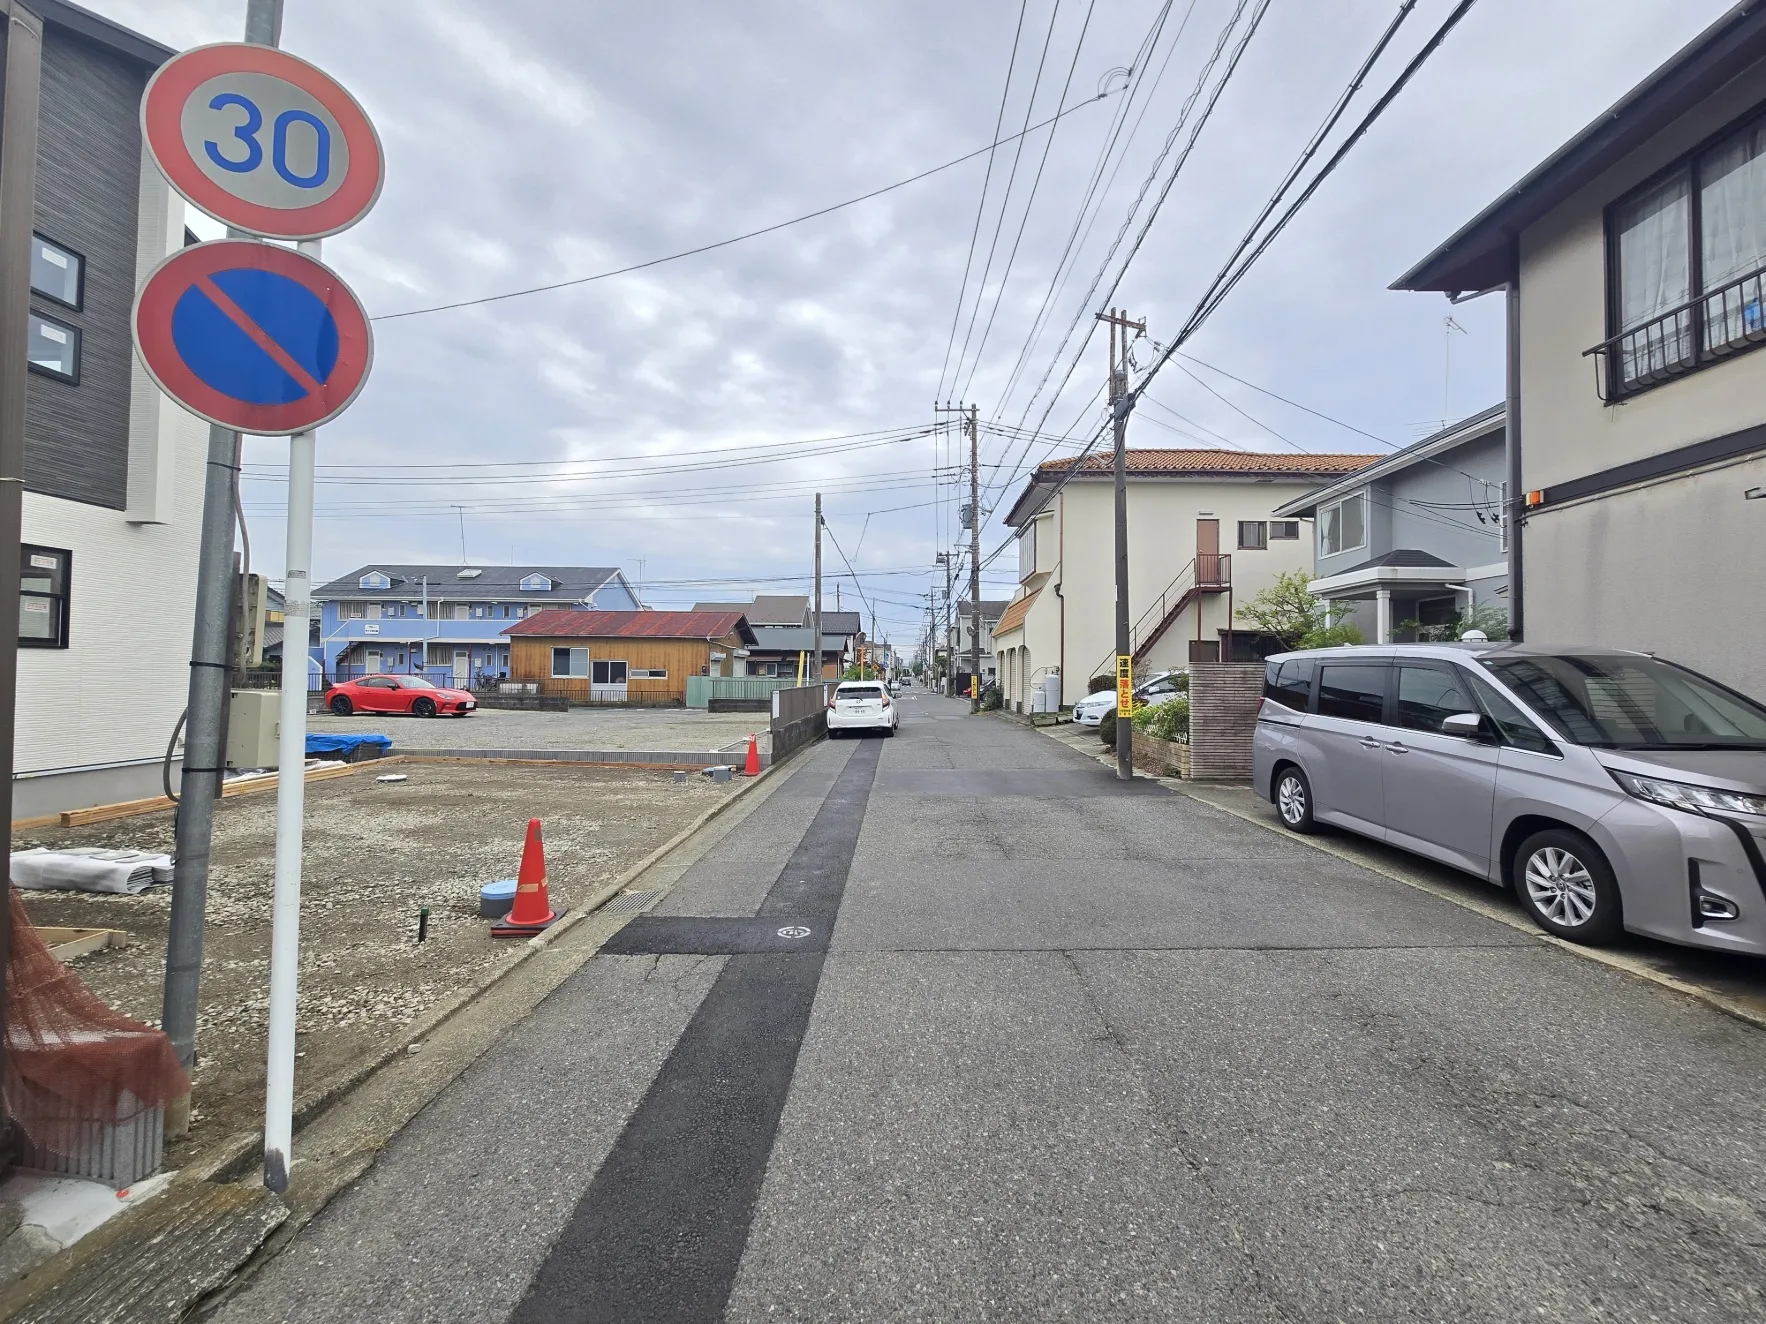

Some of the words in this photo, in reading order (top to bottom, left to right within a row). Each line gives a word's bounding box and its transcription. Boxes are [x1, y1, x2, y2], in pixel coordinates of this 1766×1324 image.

[204, 93, 331, 188] 30
[1120, 658, 1129, 708] 速度落とせ
